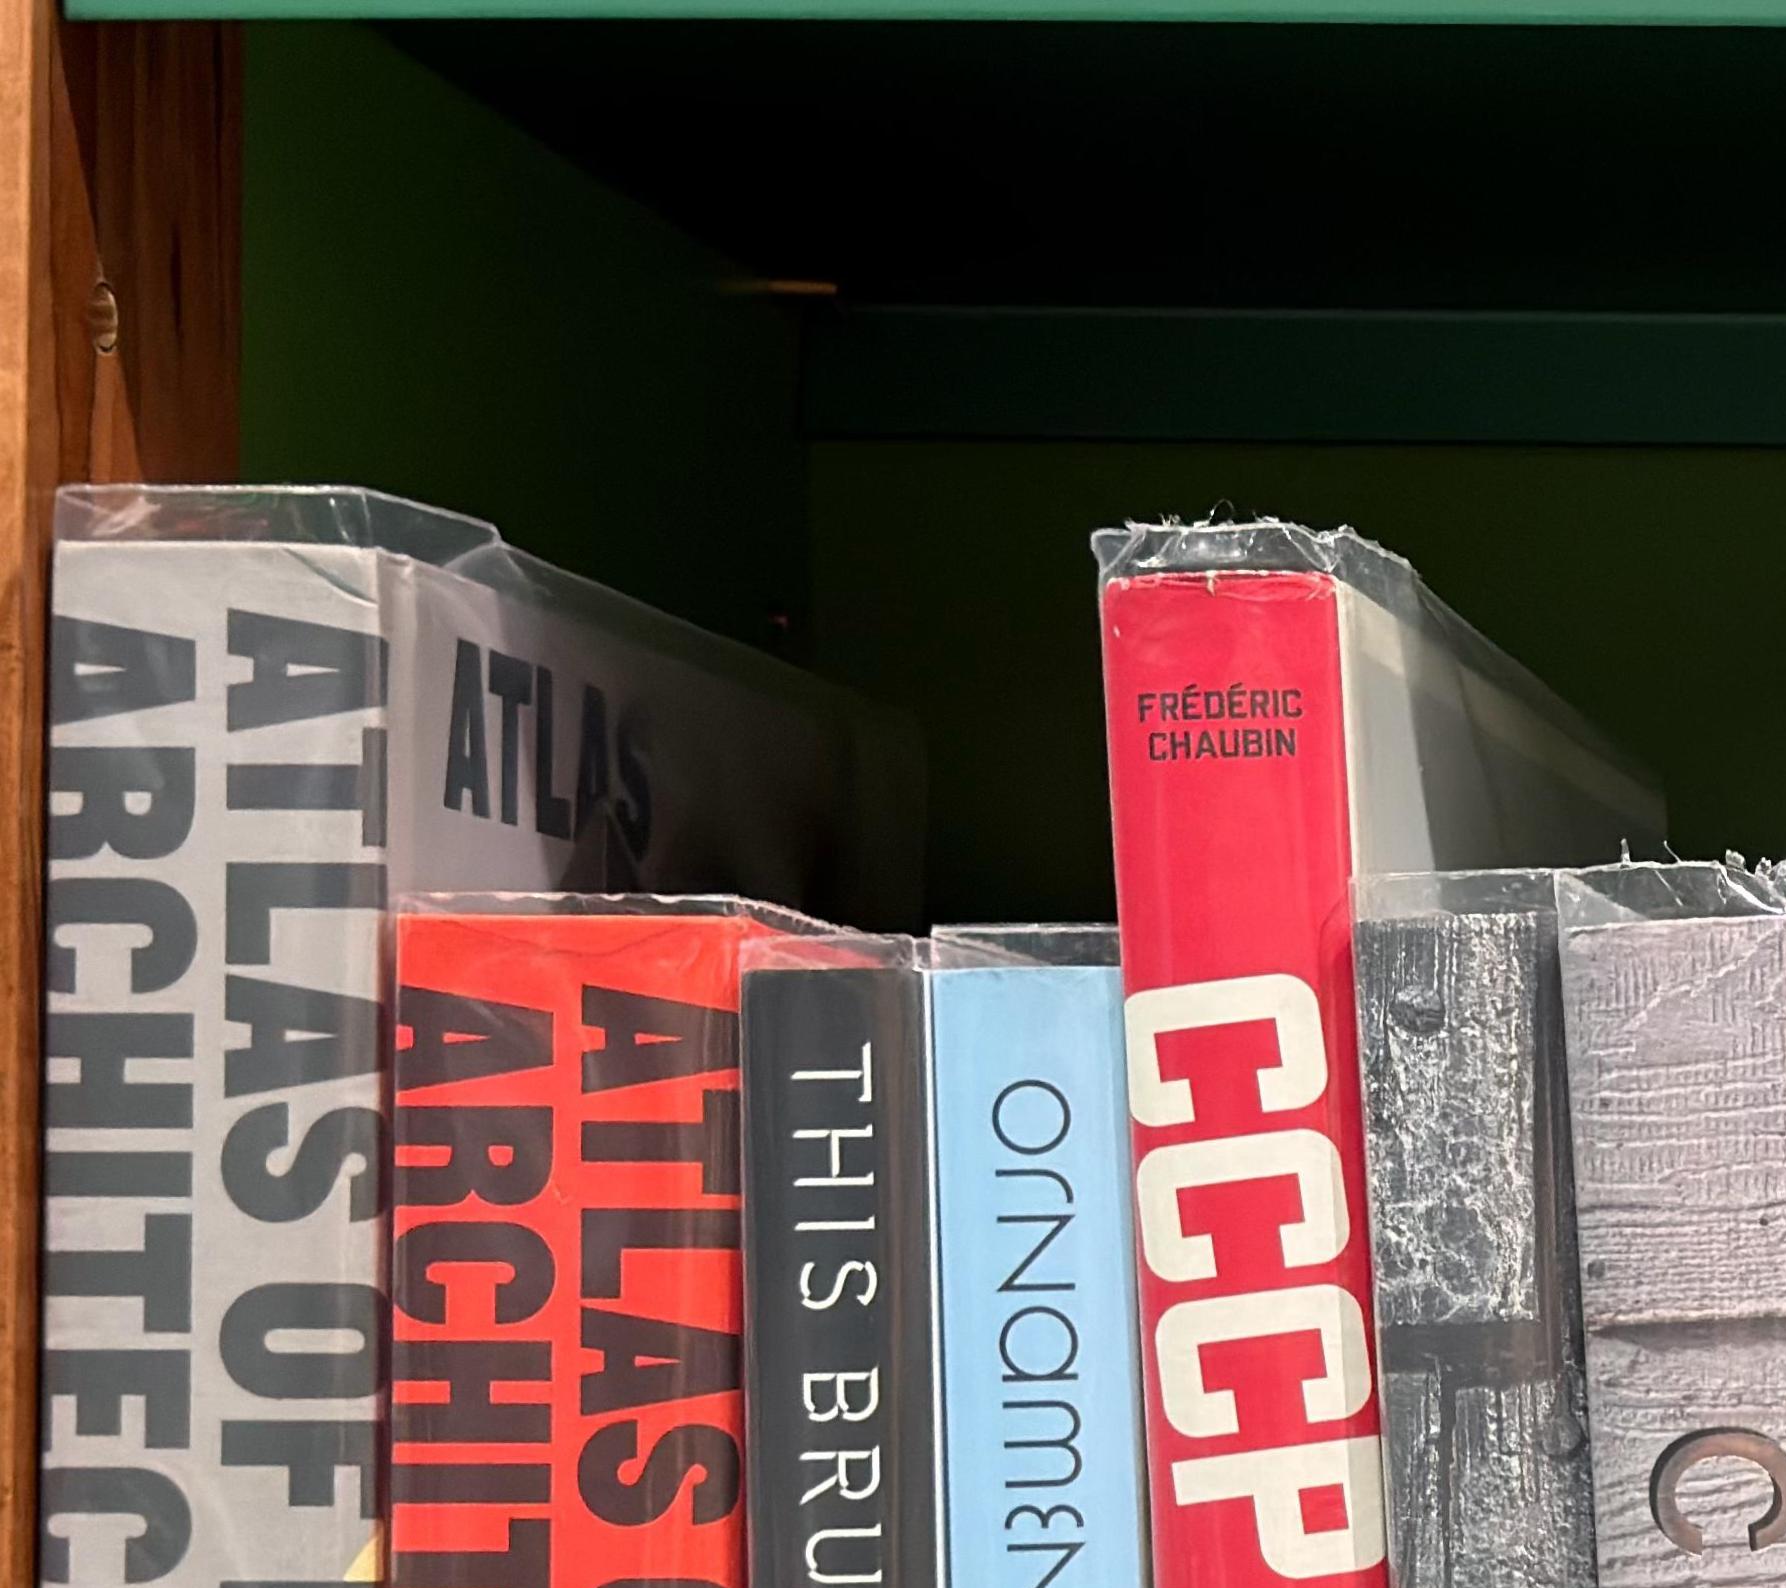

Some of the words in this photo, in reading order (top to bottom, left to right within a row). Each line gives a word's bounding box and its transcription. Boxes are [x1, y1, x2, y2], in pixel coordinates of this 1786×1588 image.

[442, 637, 653, 861] ATLAS
[1137, 682, 1303, 722] FRÉDÉRIC
[1147, 727, 1296, 762] CHAUBIN
[217, 609, 388, 1224] ATLAS
[574, 985, 741, 1529] ATLAS
[790, 1041, 877, 1311] THIS
[1124, 973, 1387, 1580] CCCP
[213, 1283, 386, 1524] OF
